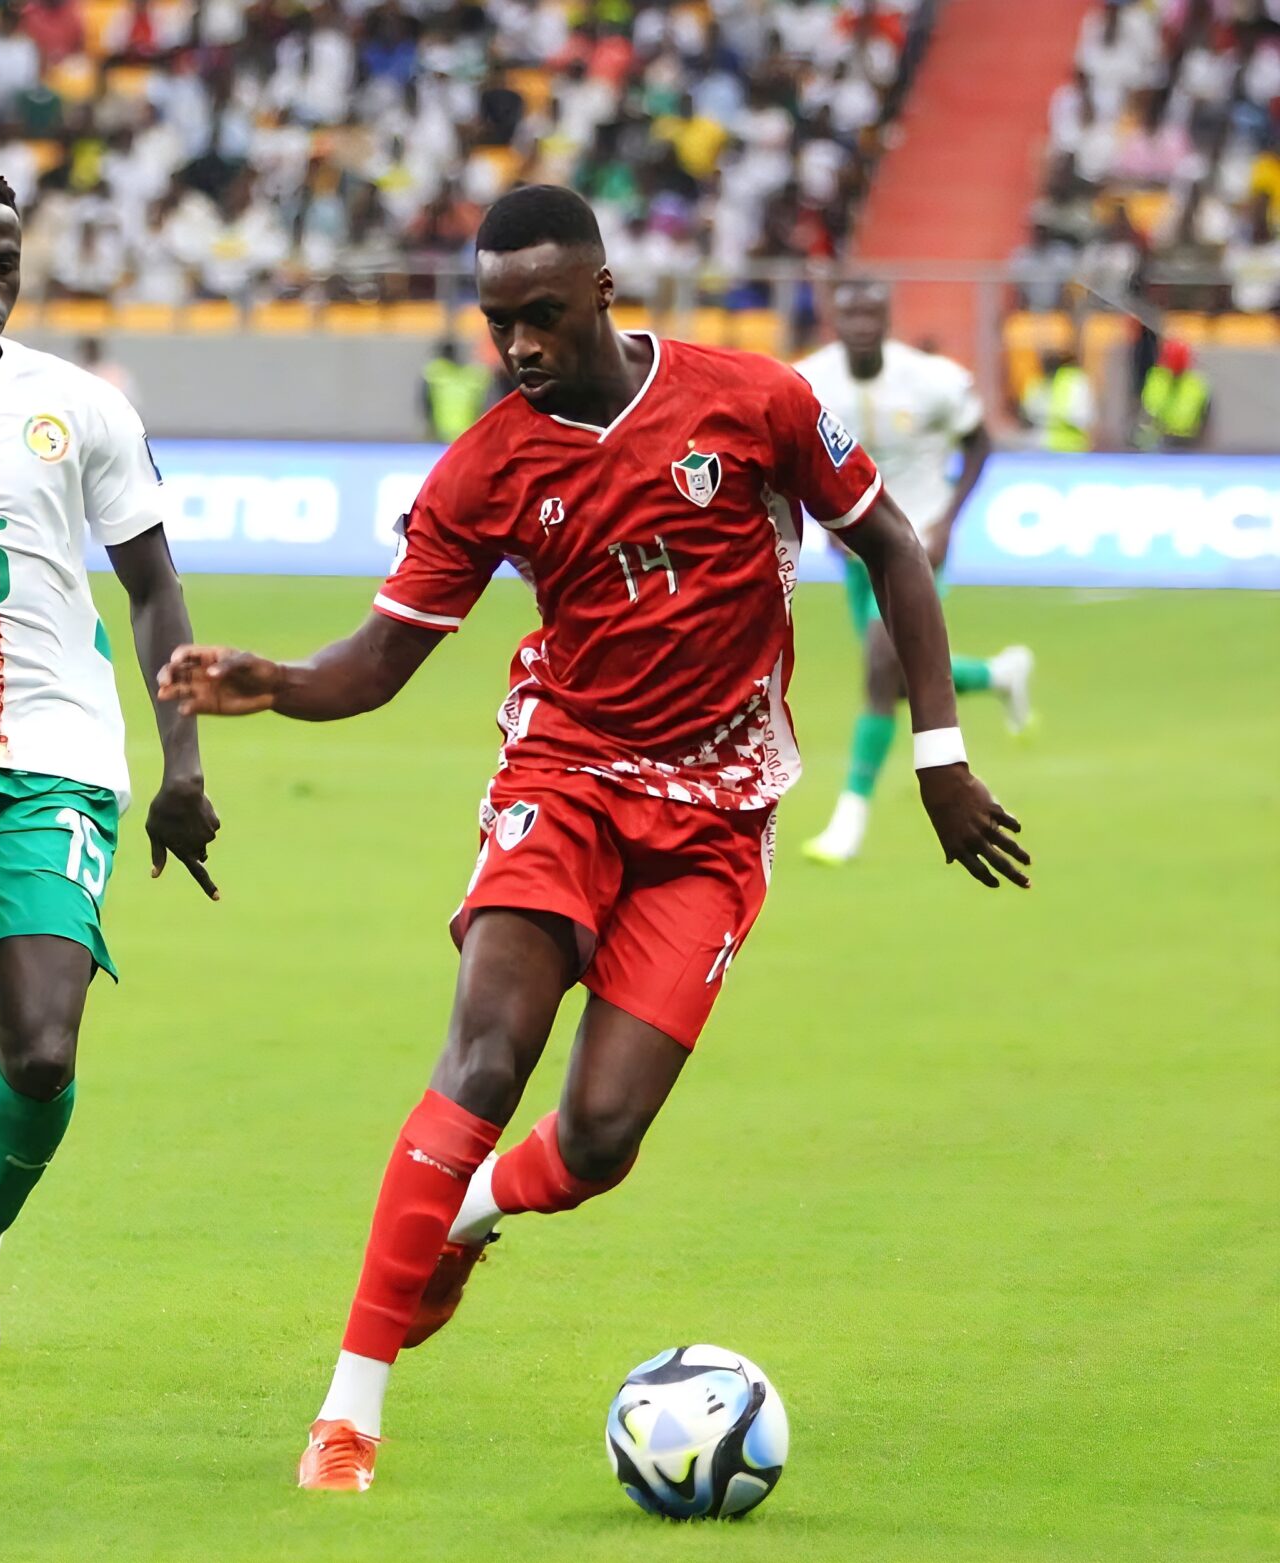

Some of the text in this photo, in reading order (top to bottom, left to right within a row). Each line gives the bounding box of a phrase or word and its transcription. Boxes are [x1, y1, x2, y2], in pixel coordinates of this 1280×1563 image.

[608, 534, 680, 603] 14
[55, 808, 105, 897] 15
[705, 931, 733, 984] 1
